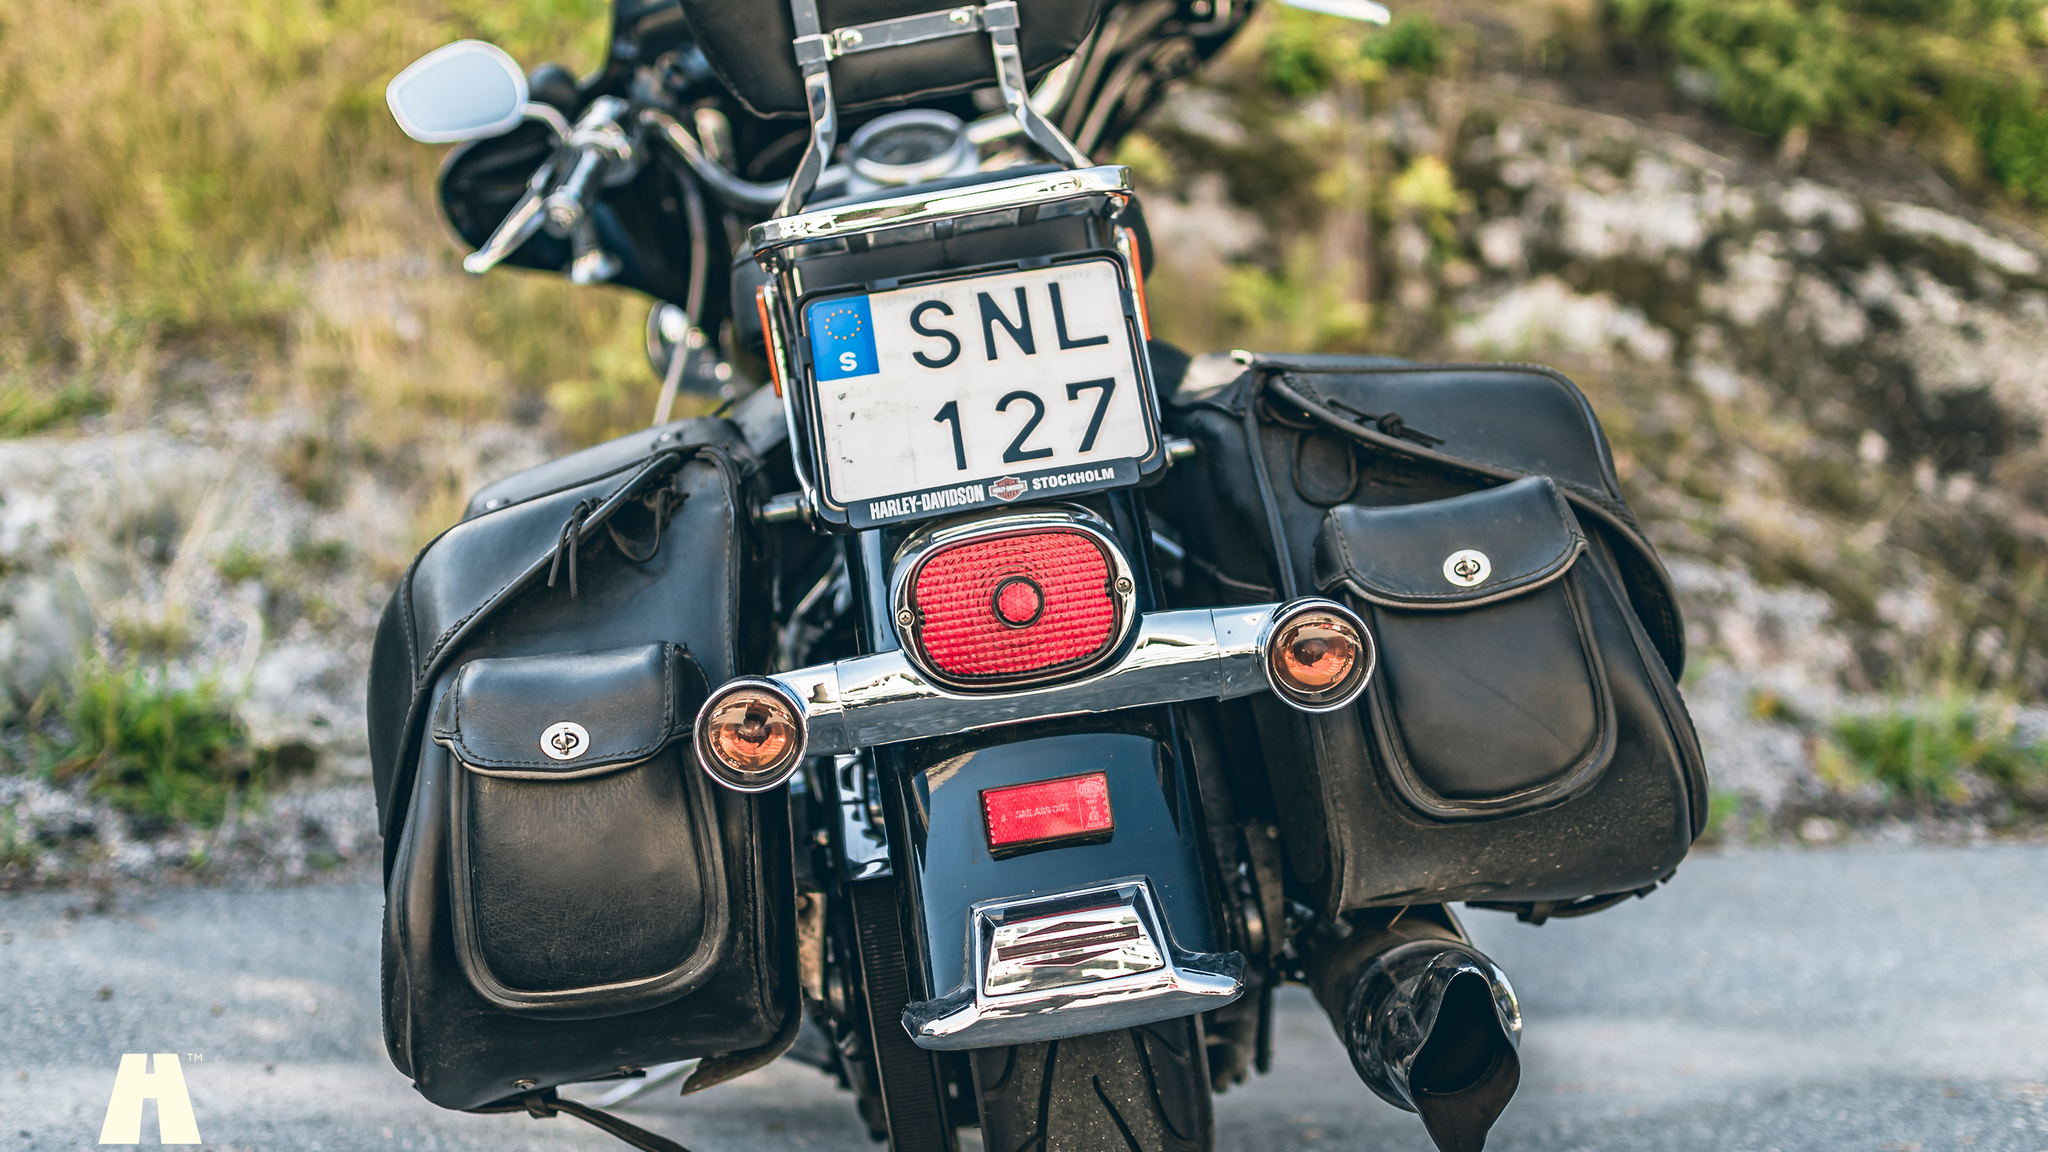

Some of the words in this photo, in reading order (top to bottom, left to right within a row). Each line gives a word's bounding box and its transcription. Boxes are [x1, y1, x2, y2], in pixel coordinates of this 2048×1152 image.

[910, 282, 1109, 368] SNL
[839, 352, 857, 371] S
[934, 377, 1116, 470] 127
[869, 484, 985, 520] HARLEY-DAVIDSON
[1032, 467, 1115, 490] STOCKHOLM
